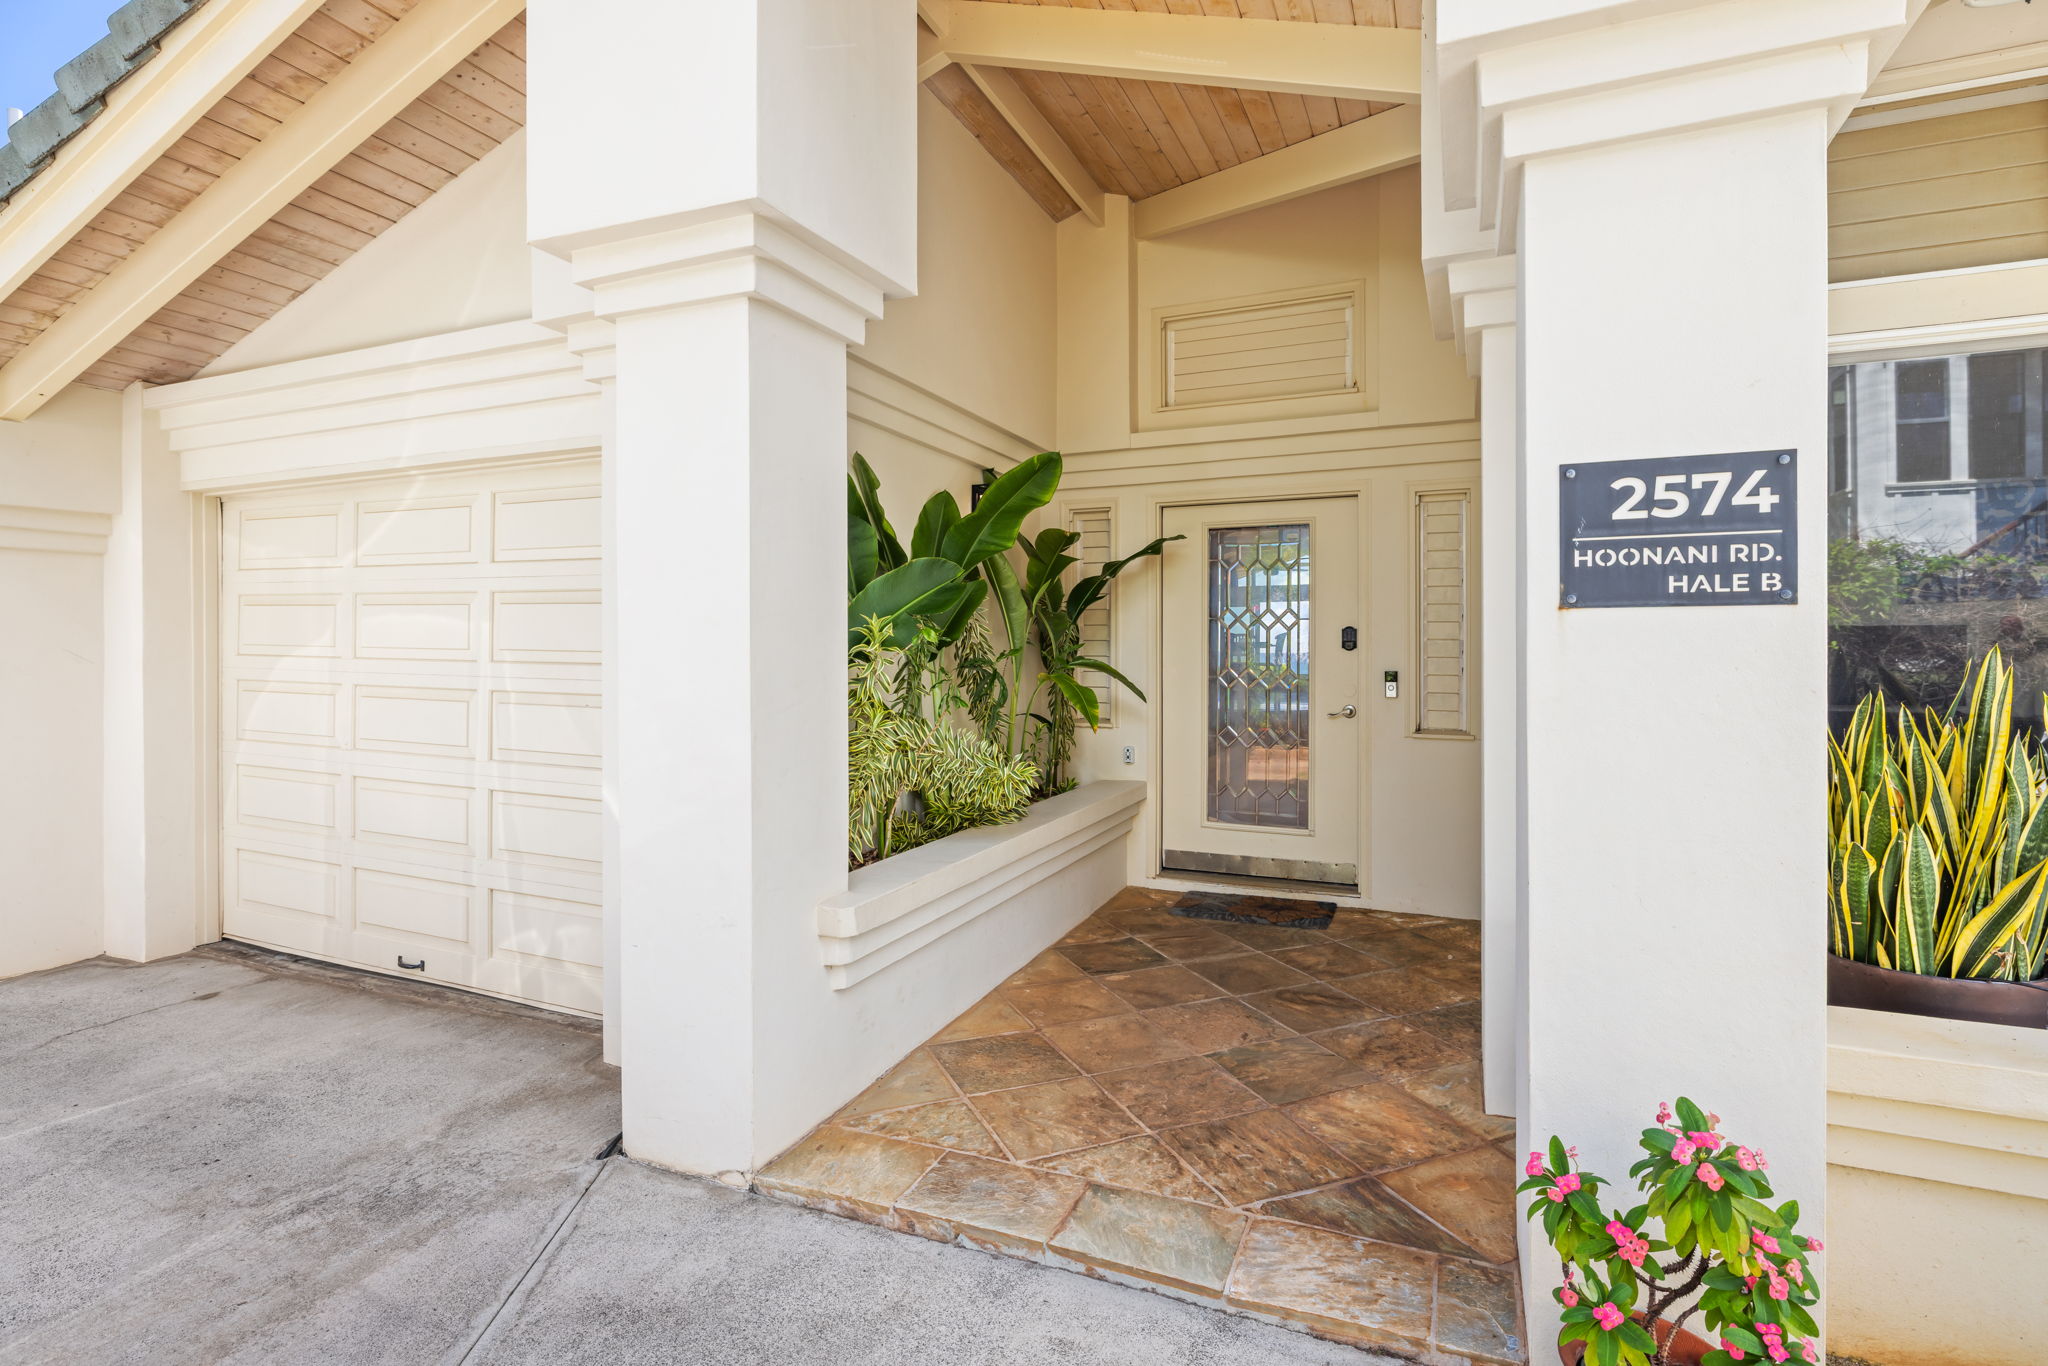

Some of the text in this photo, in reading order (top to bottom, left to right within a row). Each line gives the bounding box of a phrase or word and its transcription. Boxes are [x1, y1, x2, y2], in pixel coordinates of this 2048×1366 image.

[1609, 469, 1781, 521] 2574
[1573, 542, 1783, 568] HOONANI RD.
[1668, 572, 1783, 594] HALE B
